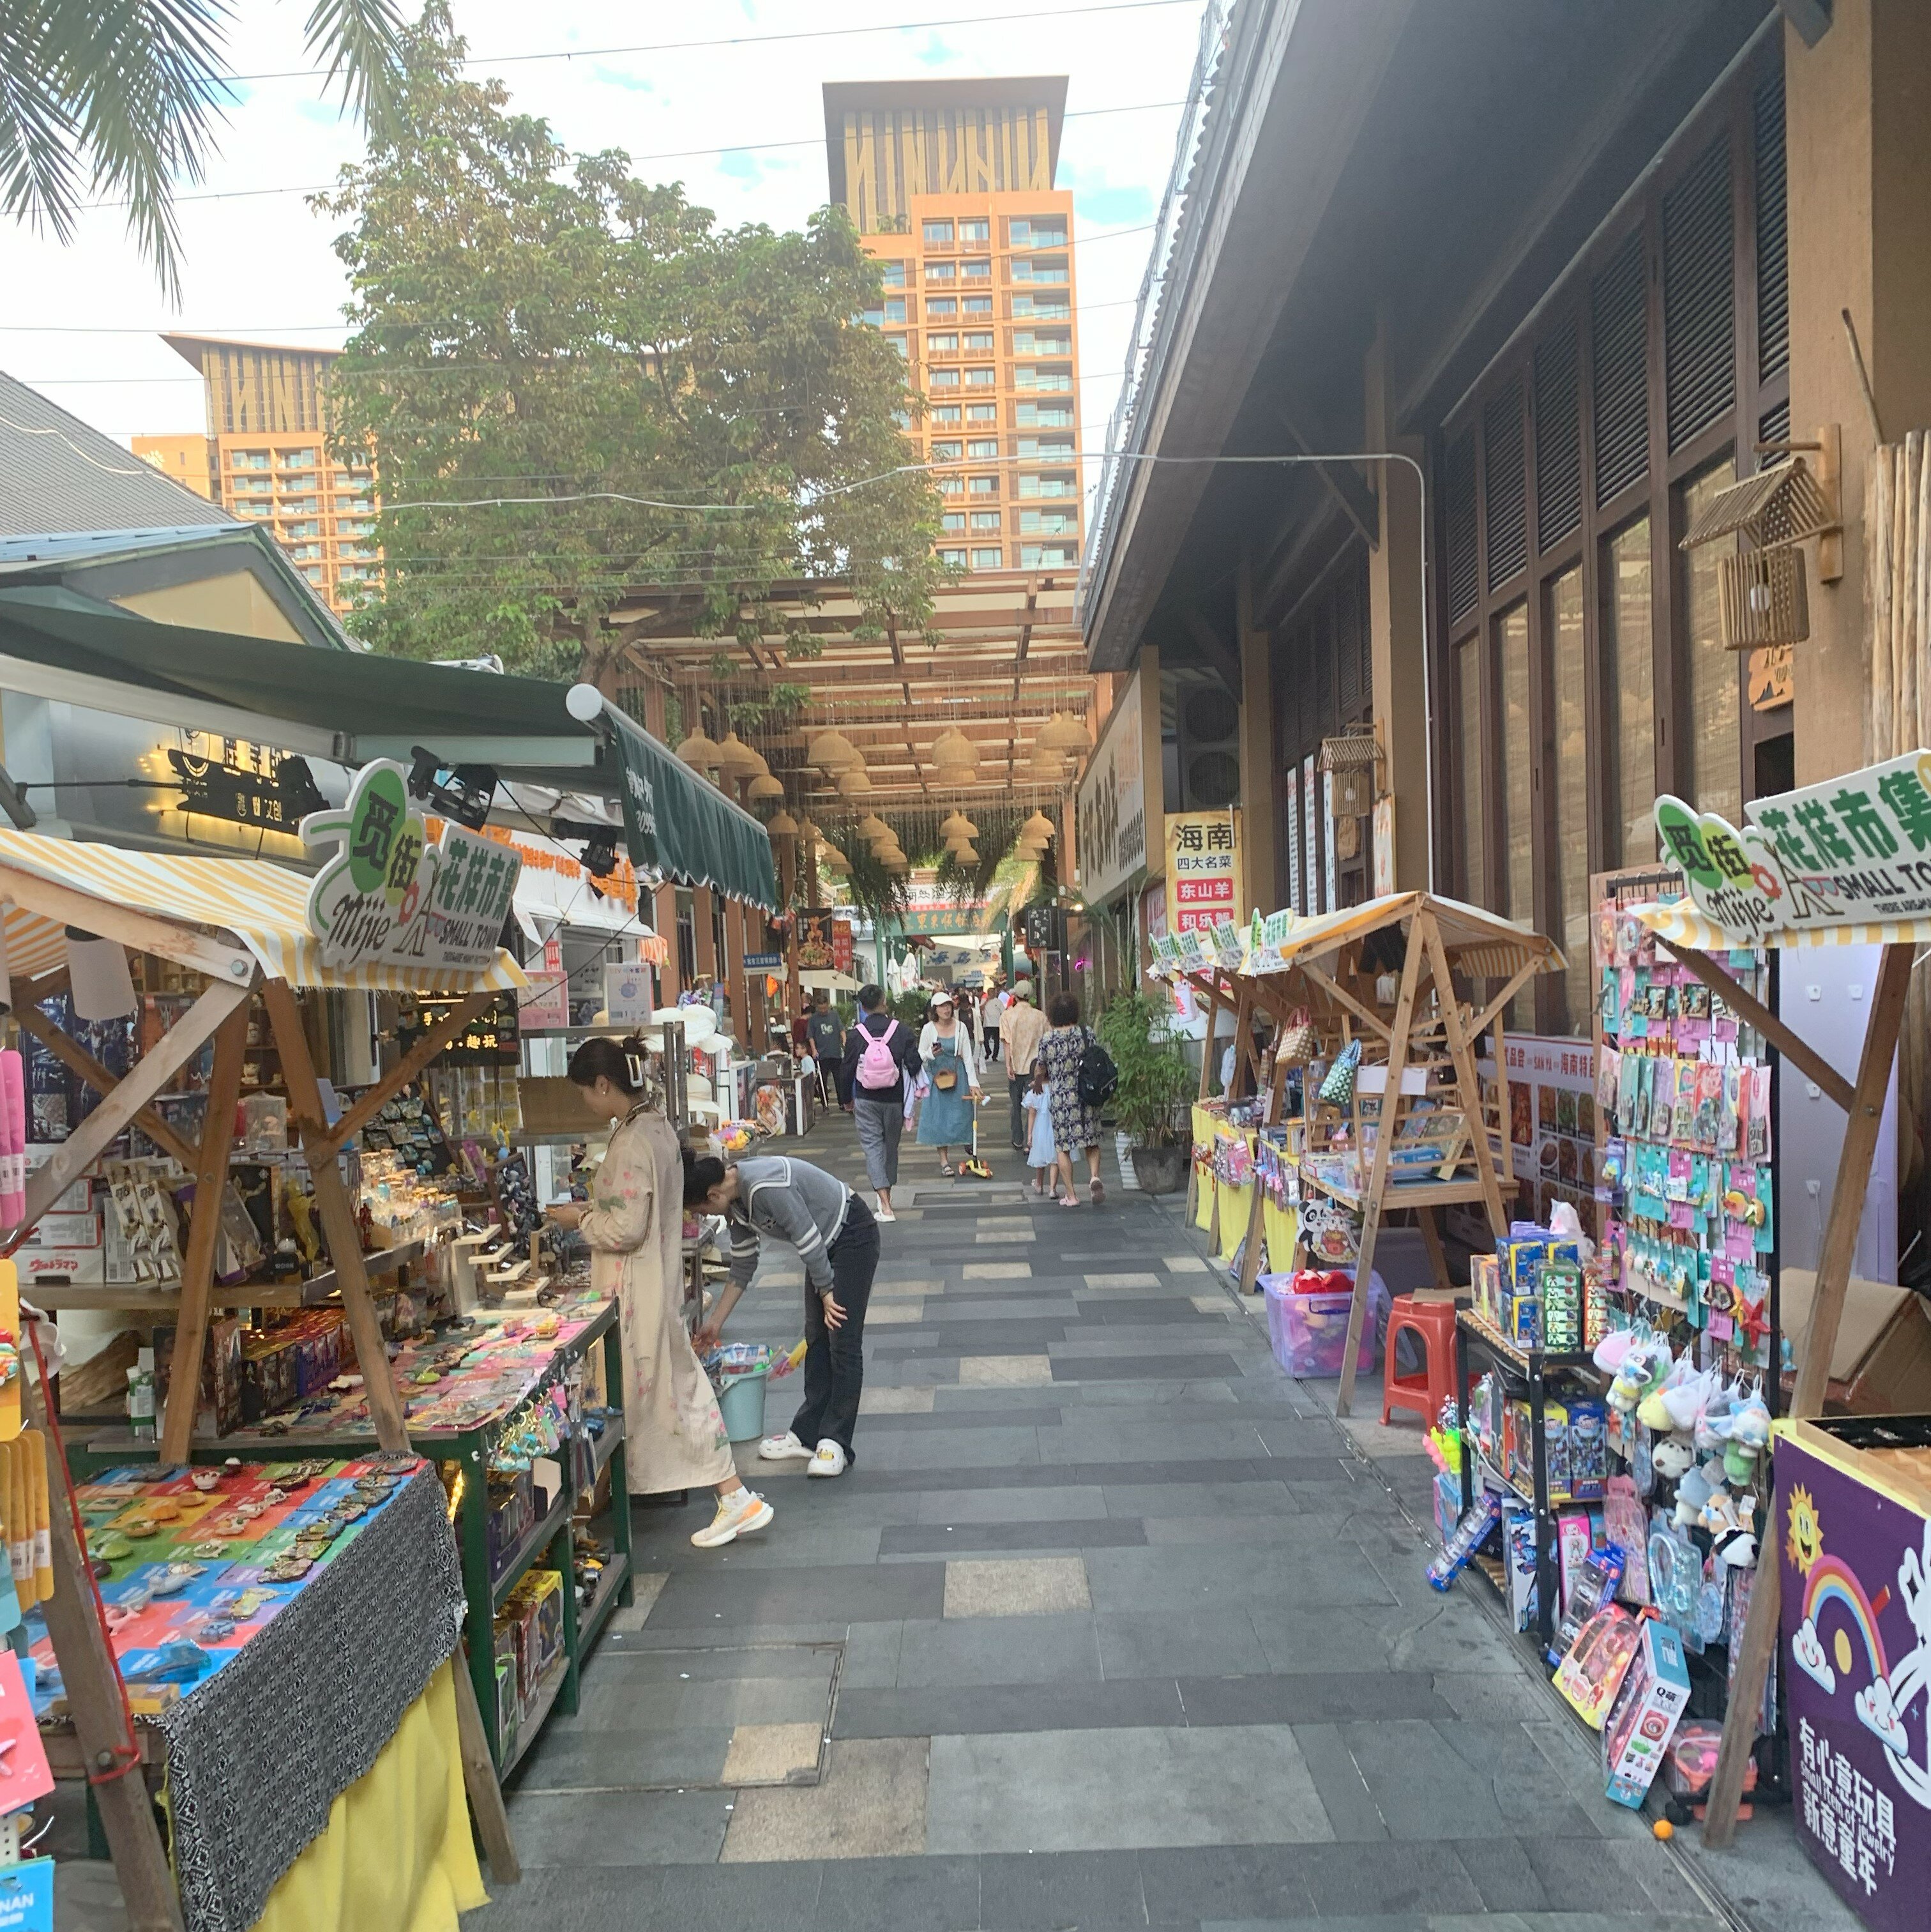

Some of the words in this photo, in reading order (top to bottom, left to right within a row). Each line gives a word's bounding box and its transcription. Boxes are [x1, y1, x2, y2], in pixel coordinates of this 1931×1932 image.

[1176, 823, 1232, 851] 海南
[1178, 855, 1232, 870] 四大名菜
[1832, 869, 1906, 901] SMALL
[1896, 861, 1931, 892] TO
[1181, 881, 1230, 899] 东山羊
[1799, 1716, 1897, 1853] 有心意玩具
[1801, 1780, 1877, 1897] 新意童年
[1858, 1818, 1895, 1878] jewelry
